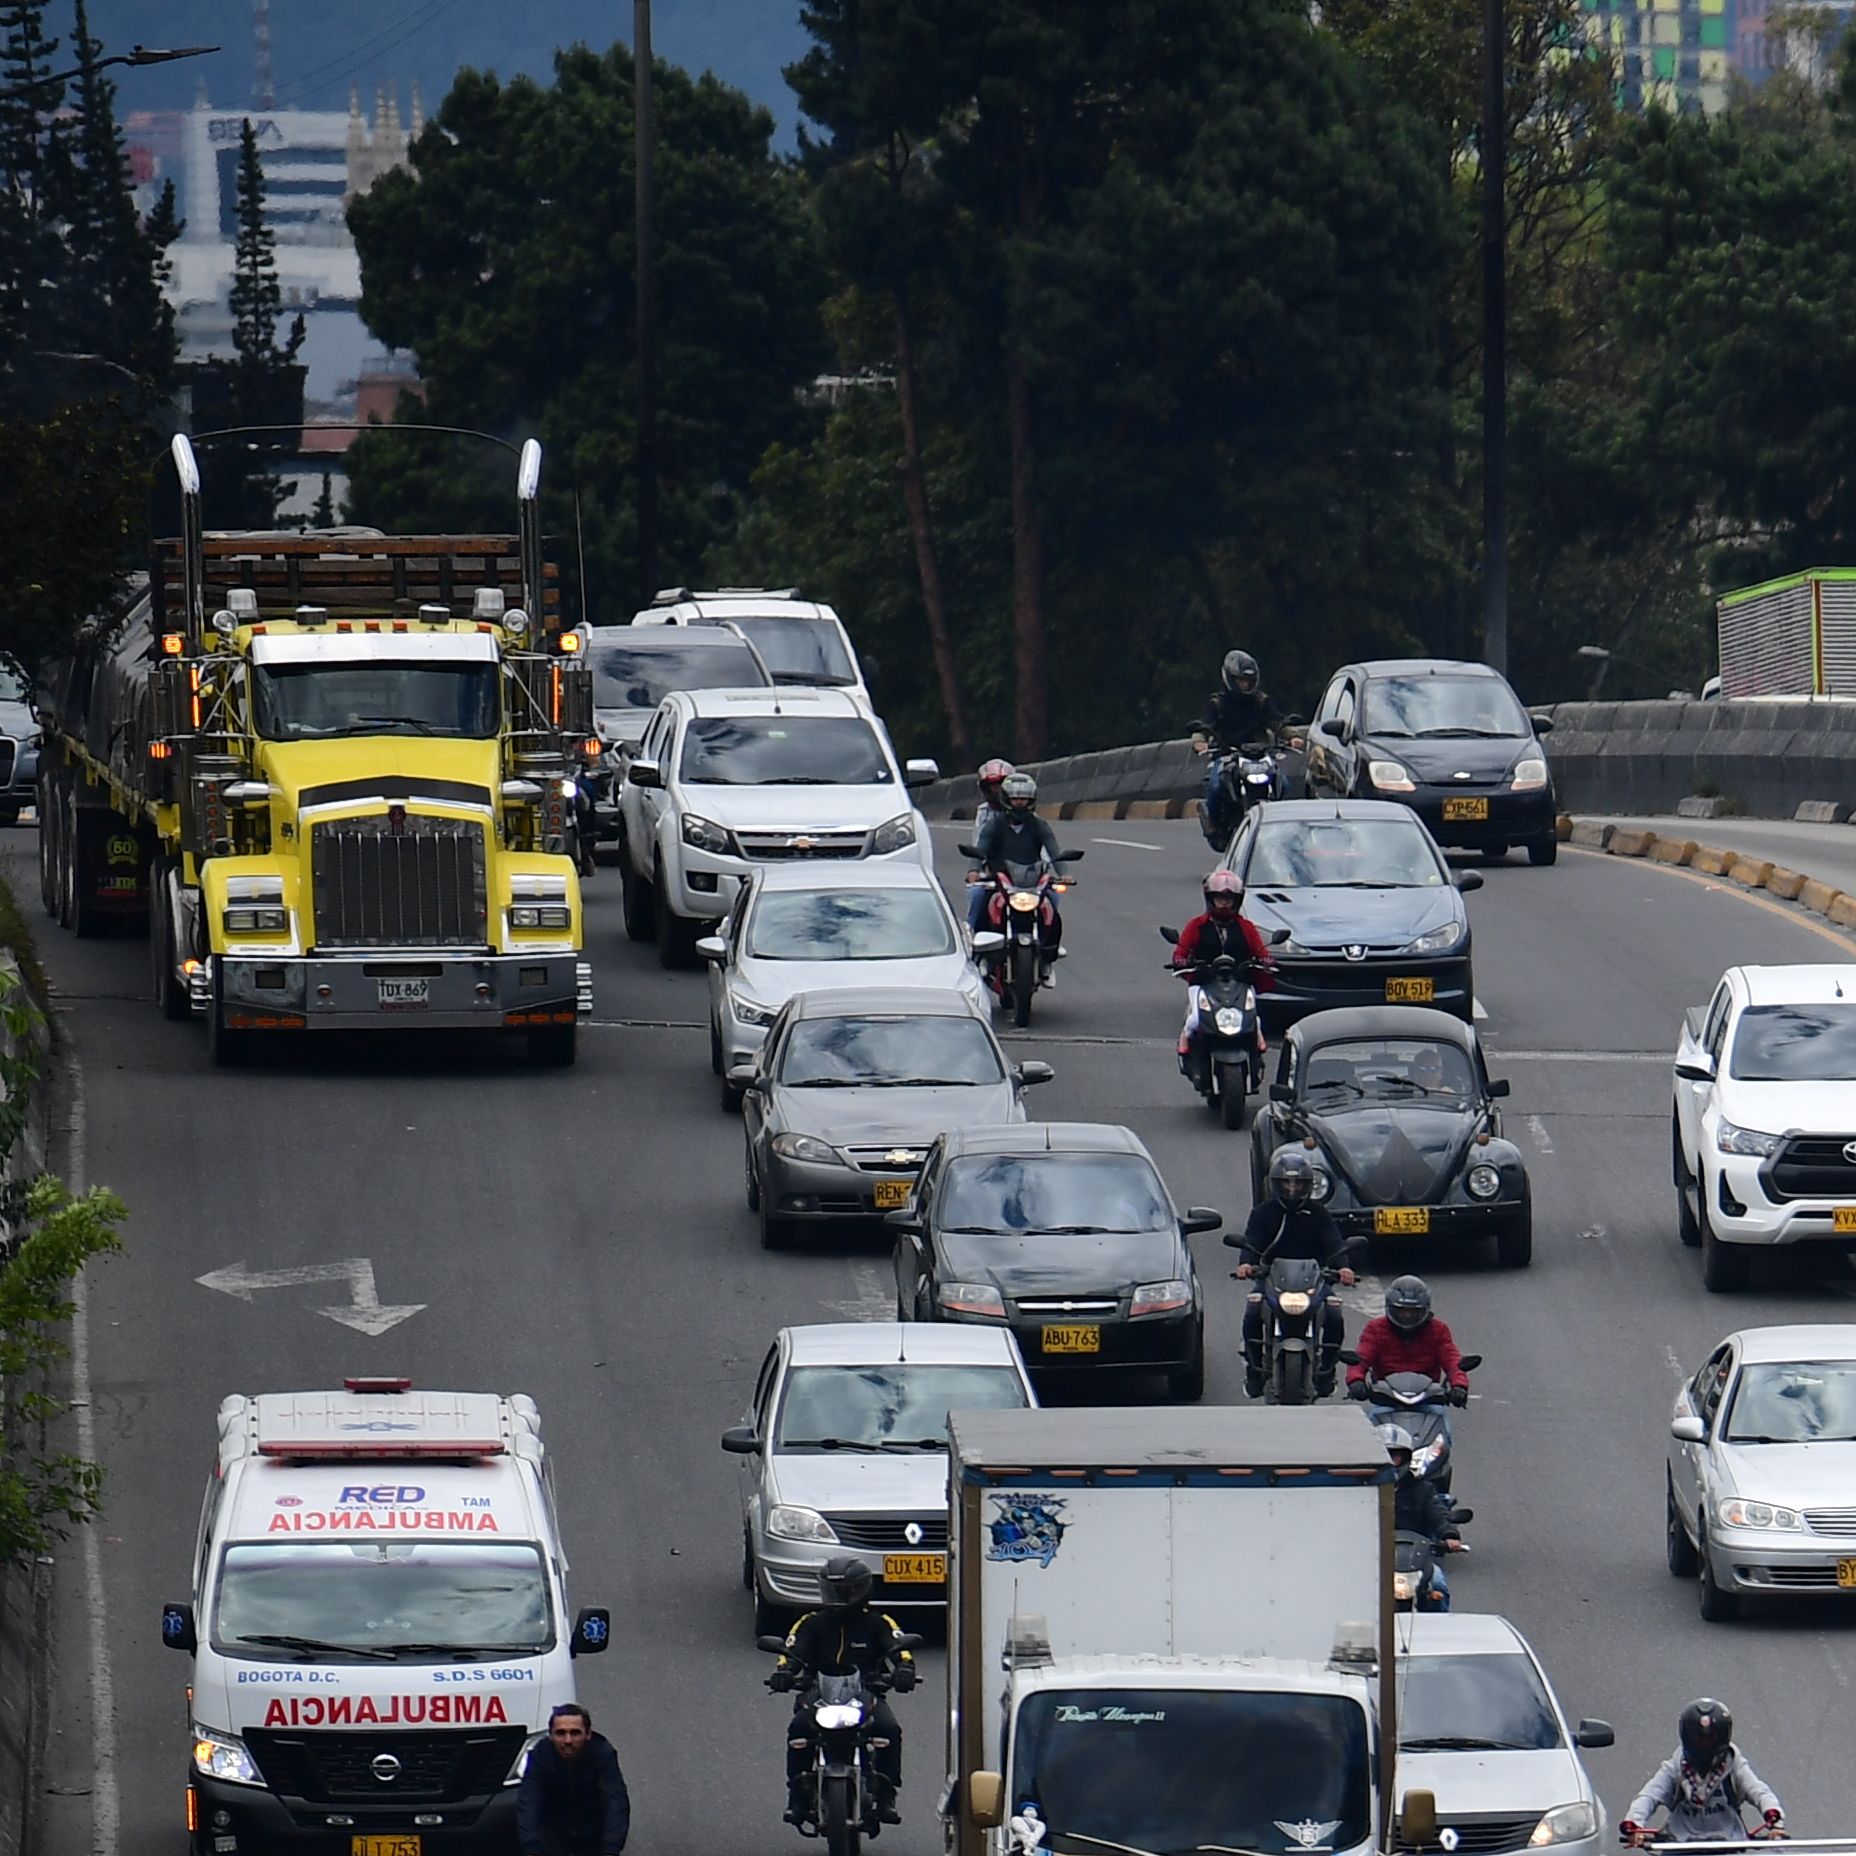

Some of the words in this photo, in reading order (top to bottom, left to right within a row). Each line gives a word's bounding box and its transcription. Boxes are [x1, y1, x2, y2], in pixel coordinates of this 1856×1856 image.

[338, 1486, 427, 1503] RED
[237, 1671, 303, 1683] BOGOTA
[490, 1668, 535, 1682] 6601
